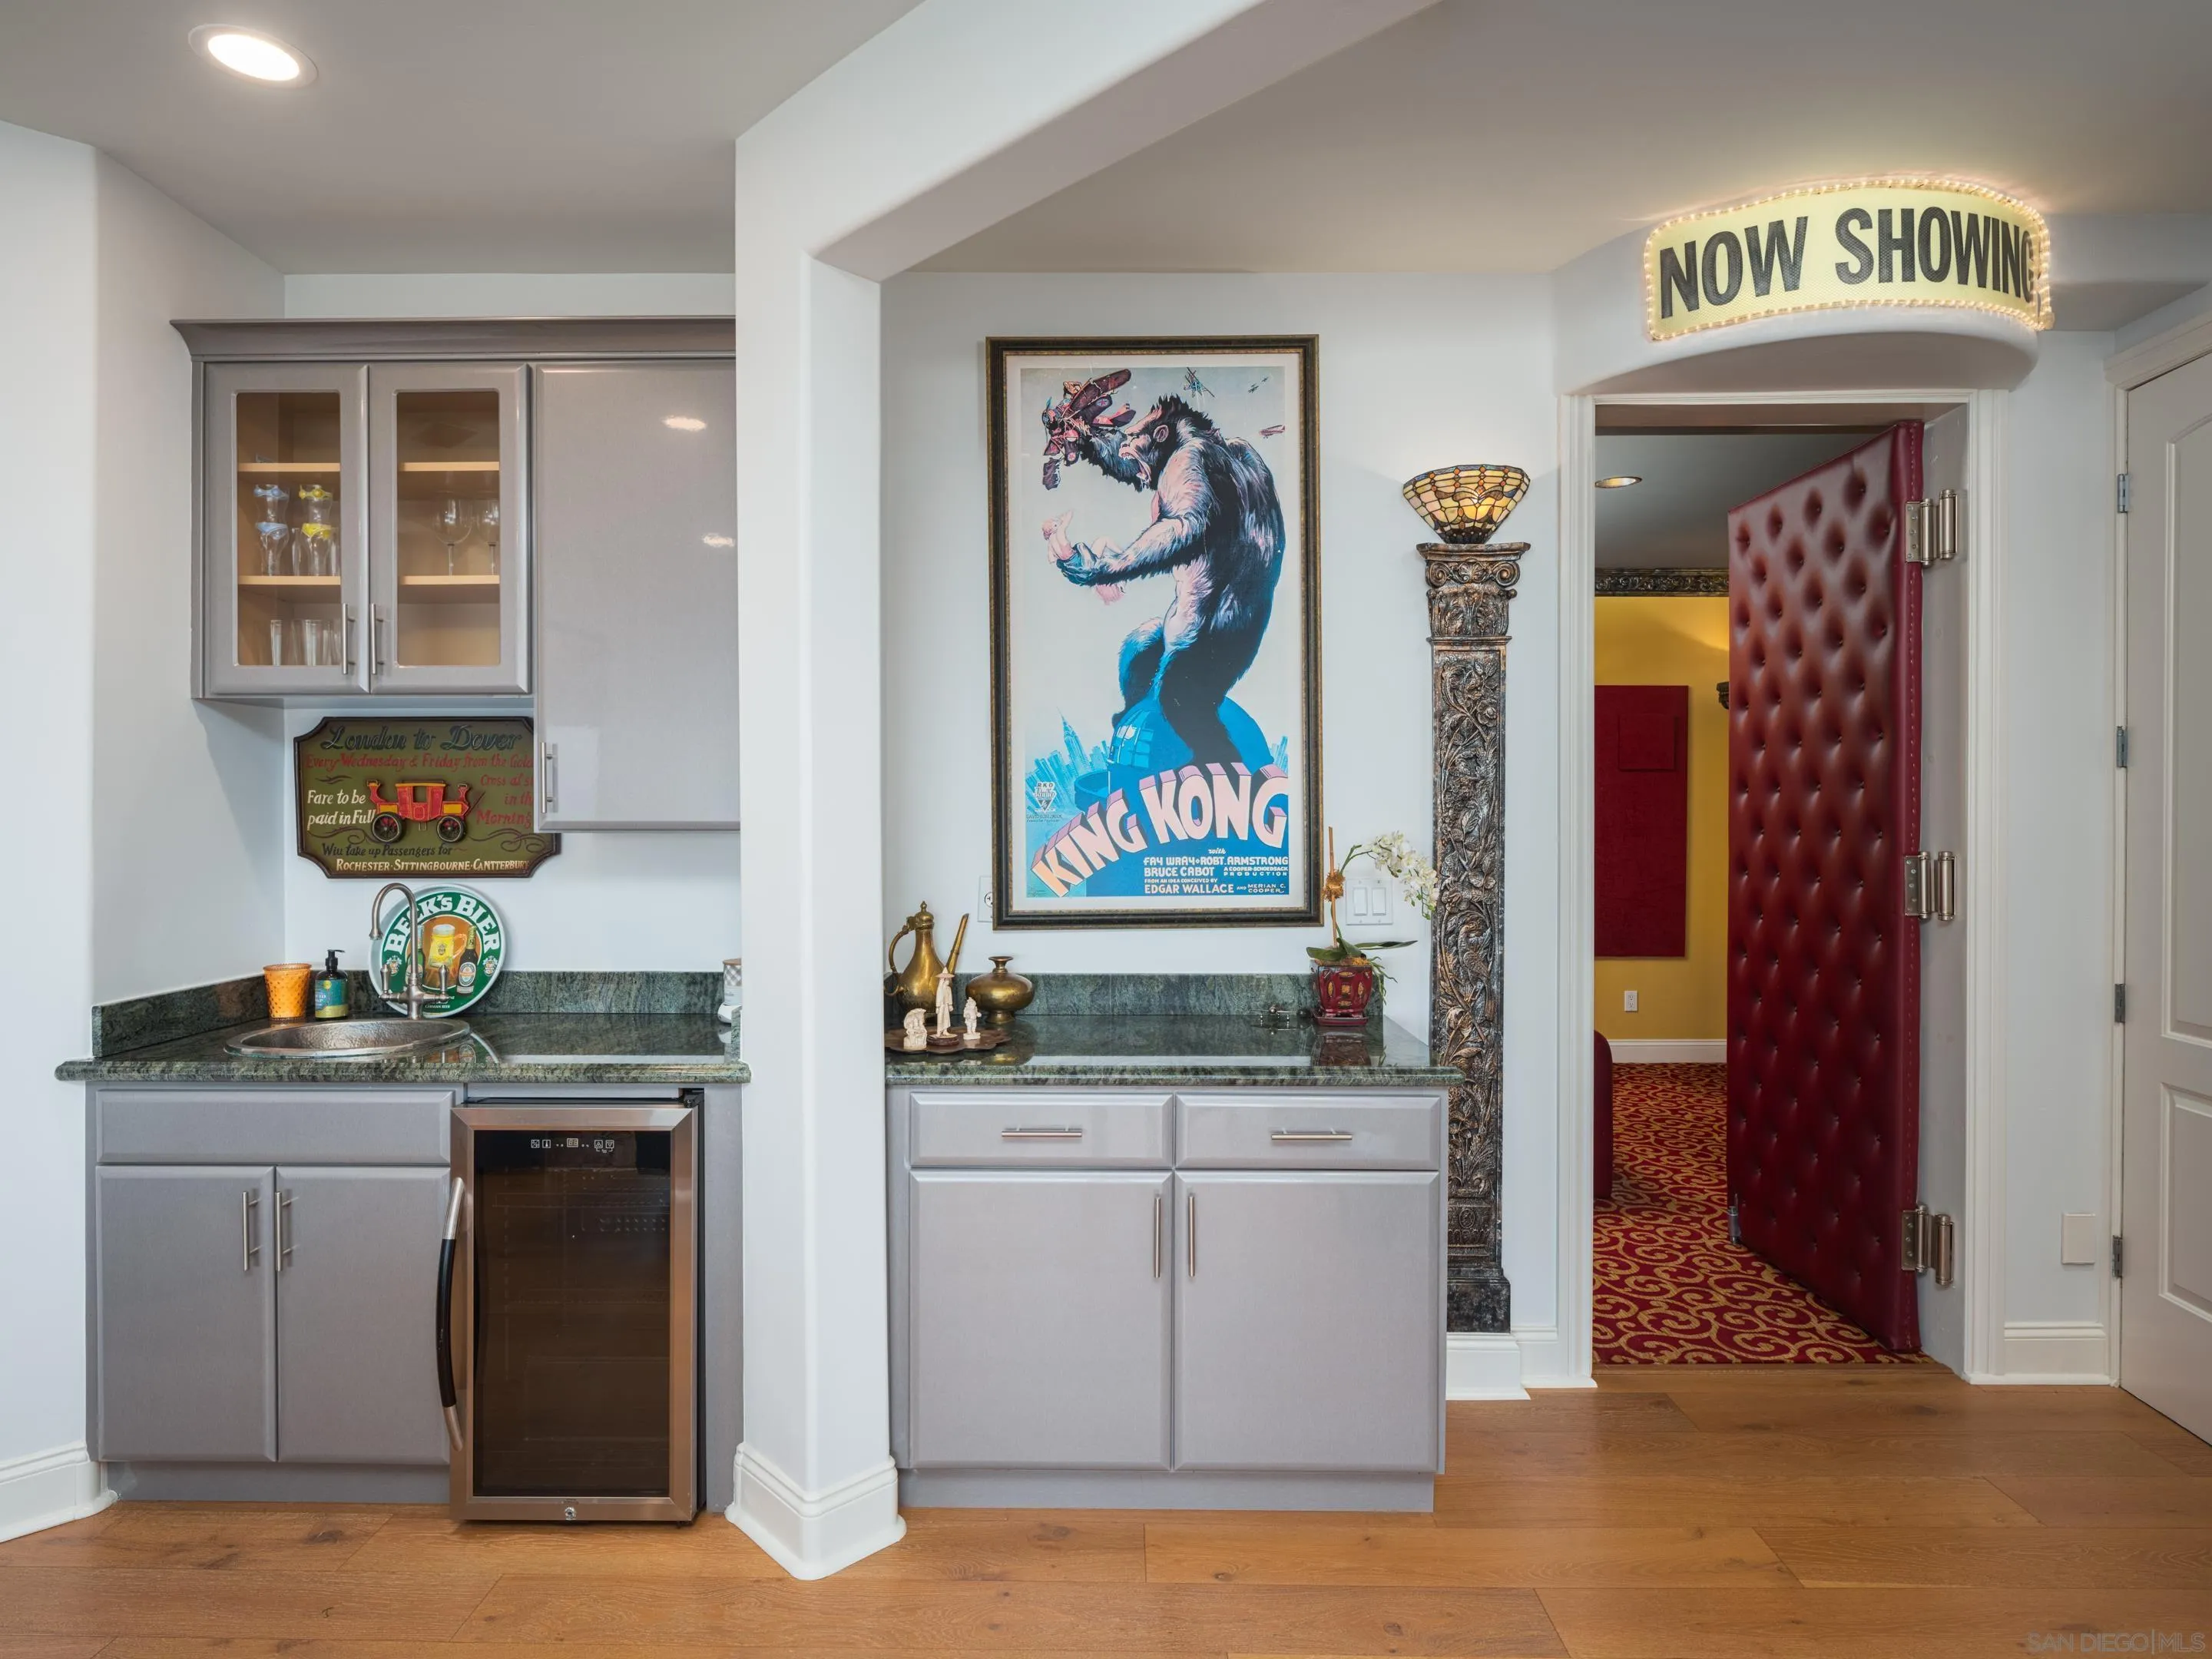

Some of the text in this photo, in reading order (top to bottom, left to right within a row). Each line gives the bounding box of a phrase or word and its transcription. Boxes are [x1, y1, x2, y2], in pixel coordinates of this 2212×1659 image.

[1660, 206, 2035, 319] NOW SHOWING
[320, 725, 522, 750] London to Dover
[306, 753, 337, 773] Every
[340, 752, 406, 771] Wednesday
[422, 753, 461, 772] Friday
[463, 753, 488, 767] from
[491, 753, 507, 767] the
[307, 789, 366, 805] Fare to be
[505, 790, 533, 806] in th
[307, 809, 376, 831] paid in Full
[476, 809, 531, 829] Morning
[1031, 762, 1289, 897] KING KONG
[345, 843, 366, 856] take
[369, 846, 381, 858] up
[381, 844, 436, 858] Passengers
[438, 843, 454, 856] for
[1144, 856, 1163, 866] FAY
[1165, 856, 1195, 866] WRAY
[1227, 856, 1289, 866] ARMSTRONG
[1144, 866, 1215, 877] BRUCE CABOT
[1144, 883, 1180, 894] EDGAR
[1182, 883, 1234, 894] WALLACE
[453, 894, 500, 954] BIER
